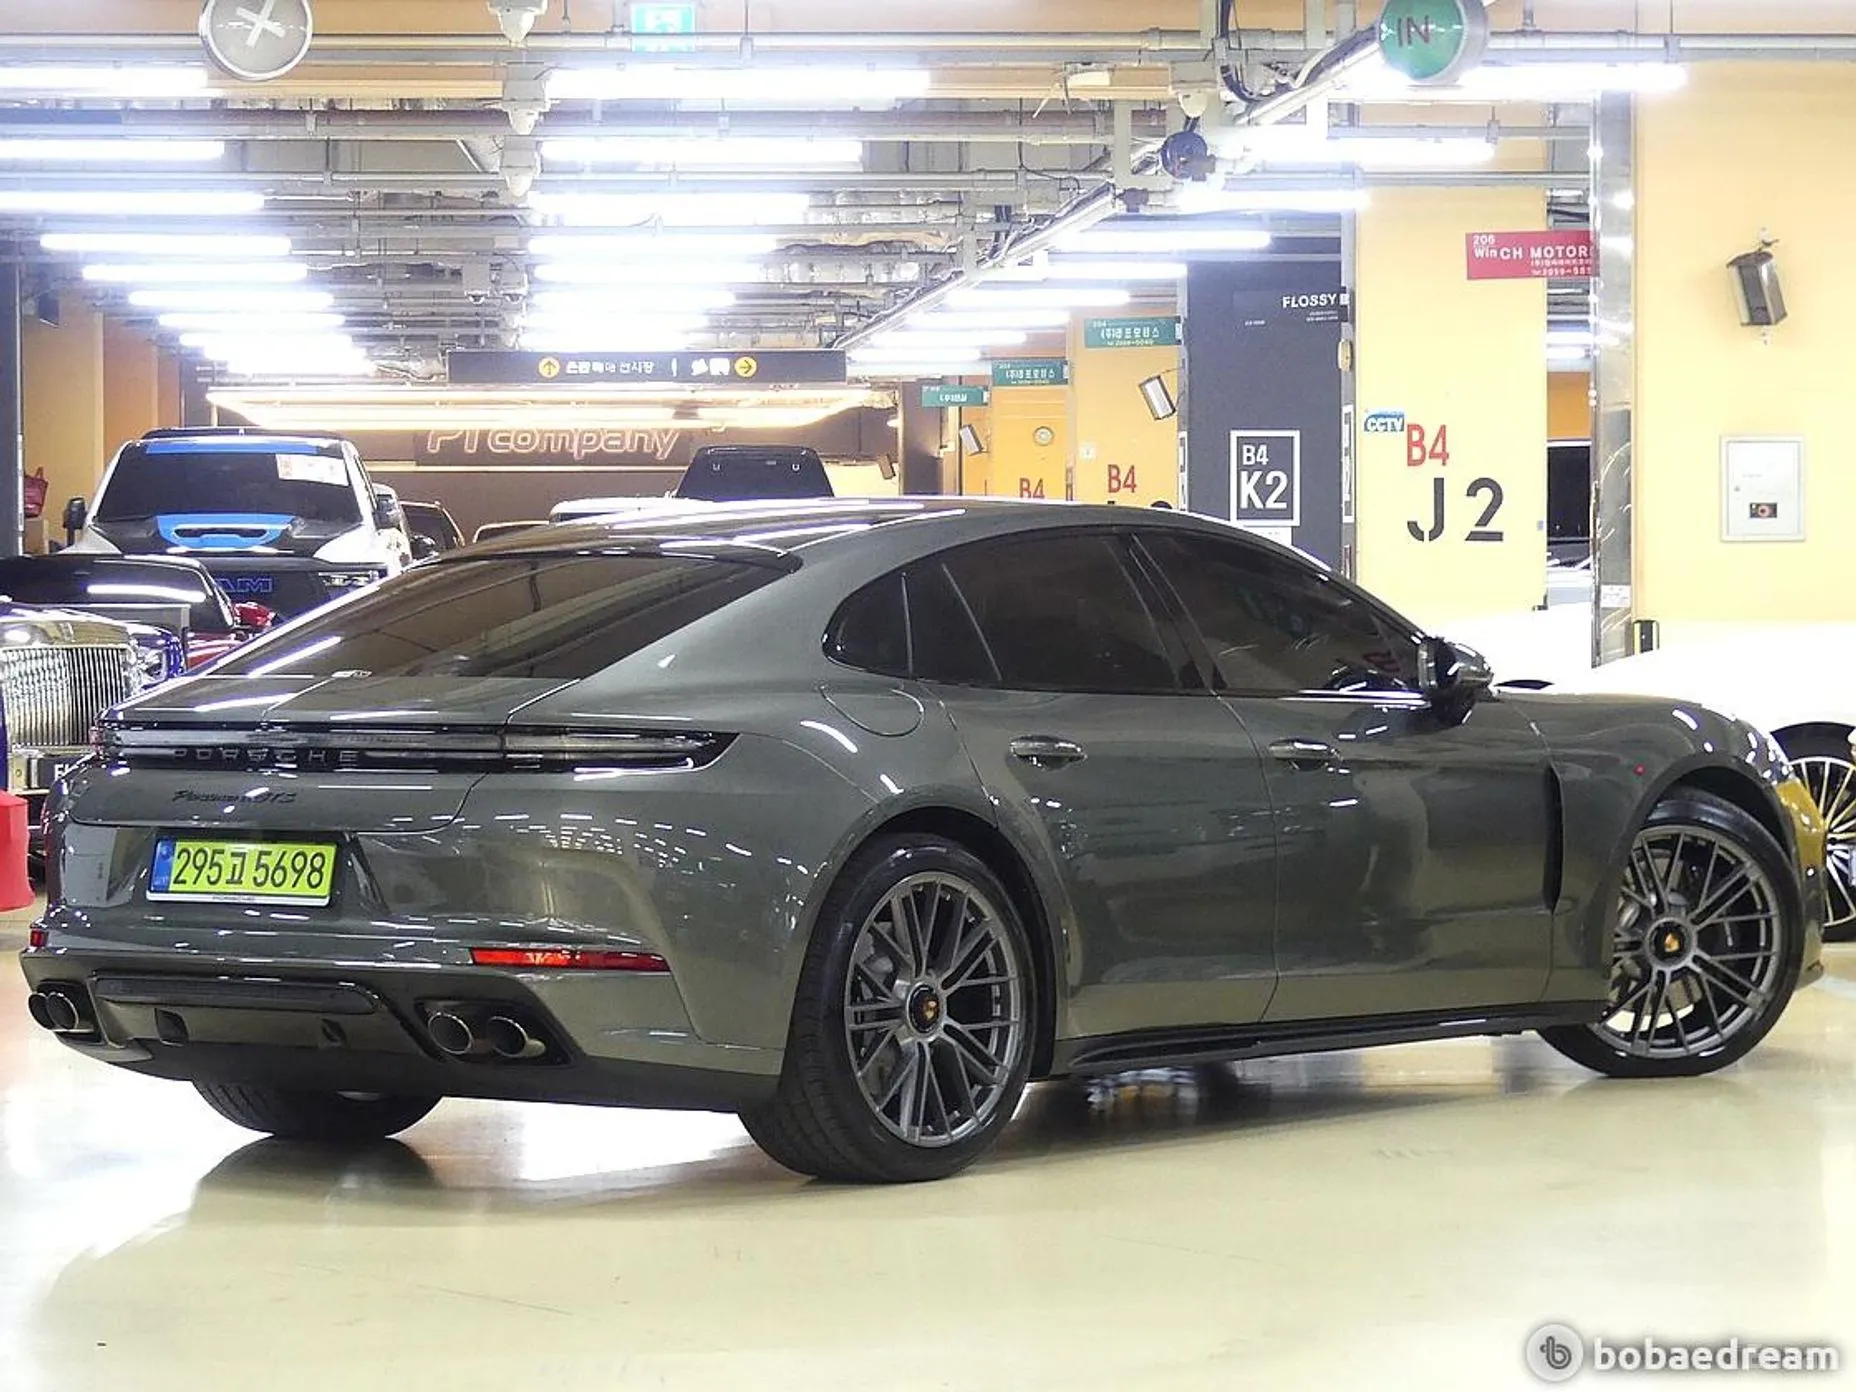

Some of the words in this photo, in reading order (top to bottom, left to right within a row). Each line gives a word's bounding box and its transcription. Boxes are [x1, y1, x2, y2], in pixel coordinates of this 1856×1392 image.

[1397, 15, 1430, 47] IN
[1530, 245, 1593, 259] MOTOR
[1282, 293, 1338, 308] FLOSSY
[1366, 417, 1405, 432] CCTV
[1241, 444, 1269, 466] B4
[1406, 424, 1450, 467] B4
[1019, 477, 1046, 499] B4
[1107, 464, 1138, 494] B4
[1239, 470, 1288, 510] K2
[216, 578, 273, 593] AM
[252, 849, 327, 890] 5698
